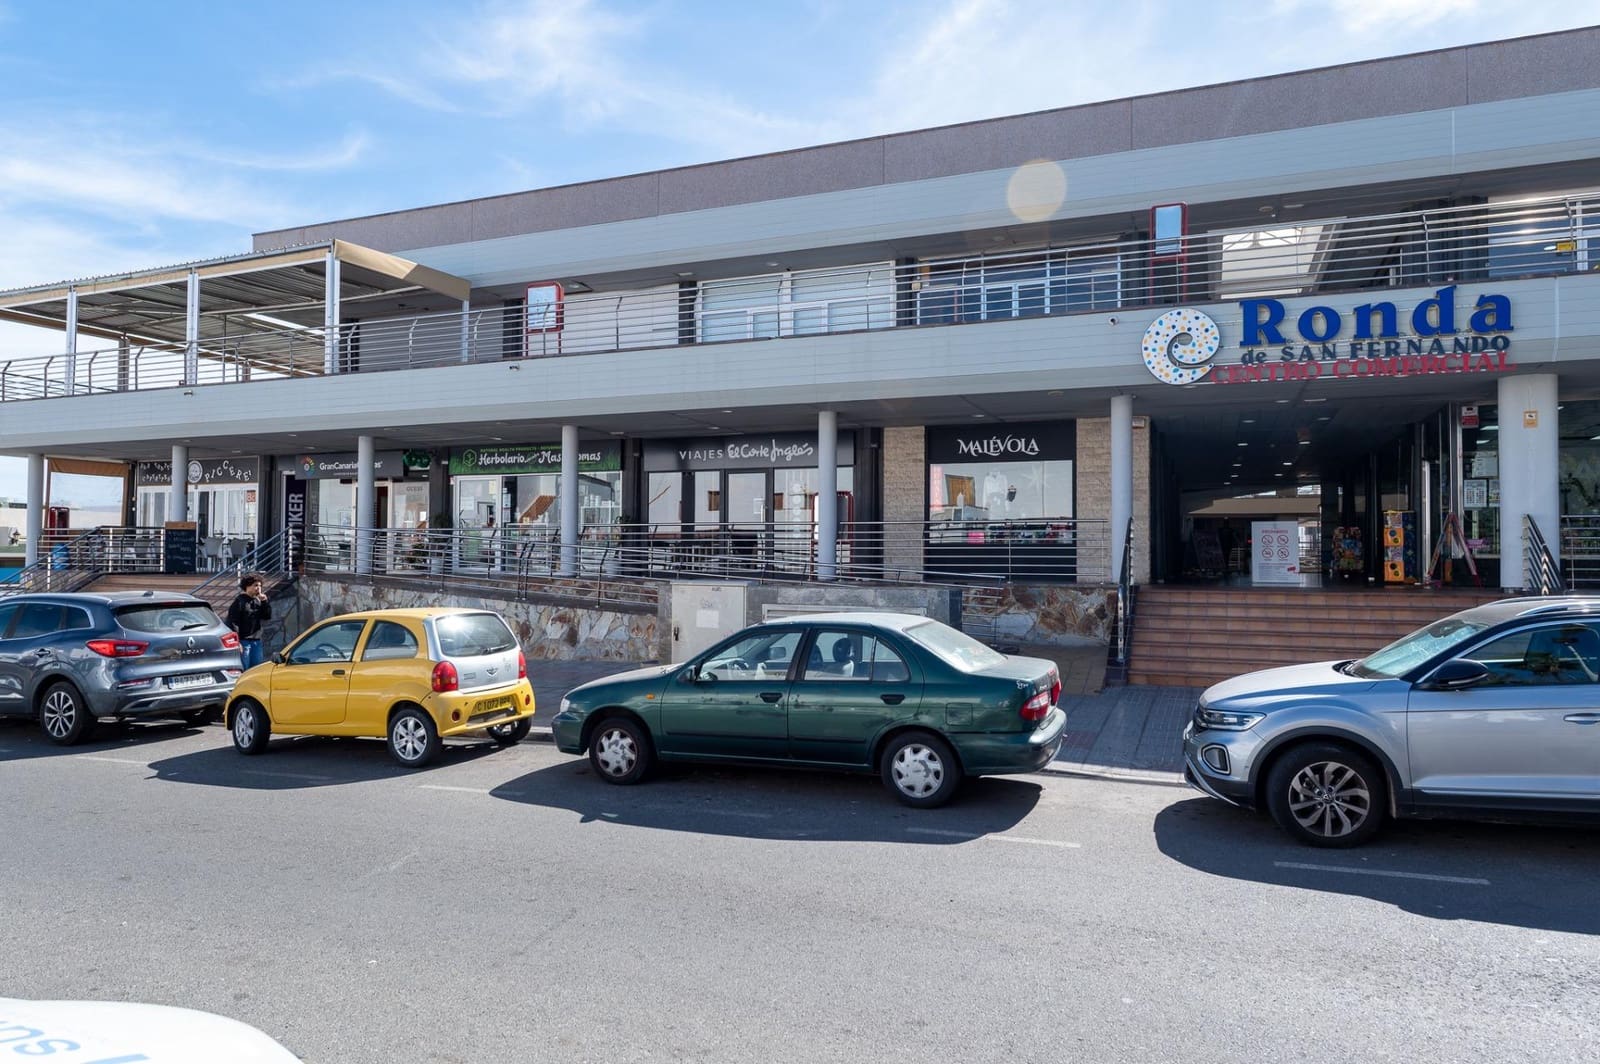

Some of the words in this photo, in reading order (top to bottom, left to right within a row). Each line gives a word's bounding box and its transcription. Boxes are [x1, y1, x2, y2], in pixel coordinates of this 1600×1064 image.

[1239, 285, 1513, 346] Ronda
[1240, 348, 1267, 364] de
[1280, 343, 1336, 361] SAN
[1350, 335, 1510, 360] FERNANDO
[1210, 361, 1322, 384] CENTRO
[1332, 352, 1517, 378] COMERCIAL
[679, 449, 724, 460] VIAJES
[727, 444, 740, 458] El
[740, 443, 769, 458] Corte
[770, 439, 813, 462] Inglés
[957, 434, 1040, 456] MALÉVOLA
[478, 452, 526, 465] Herbolario
